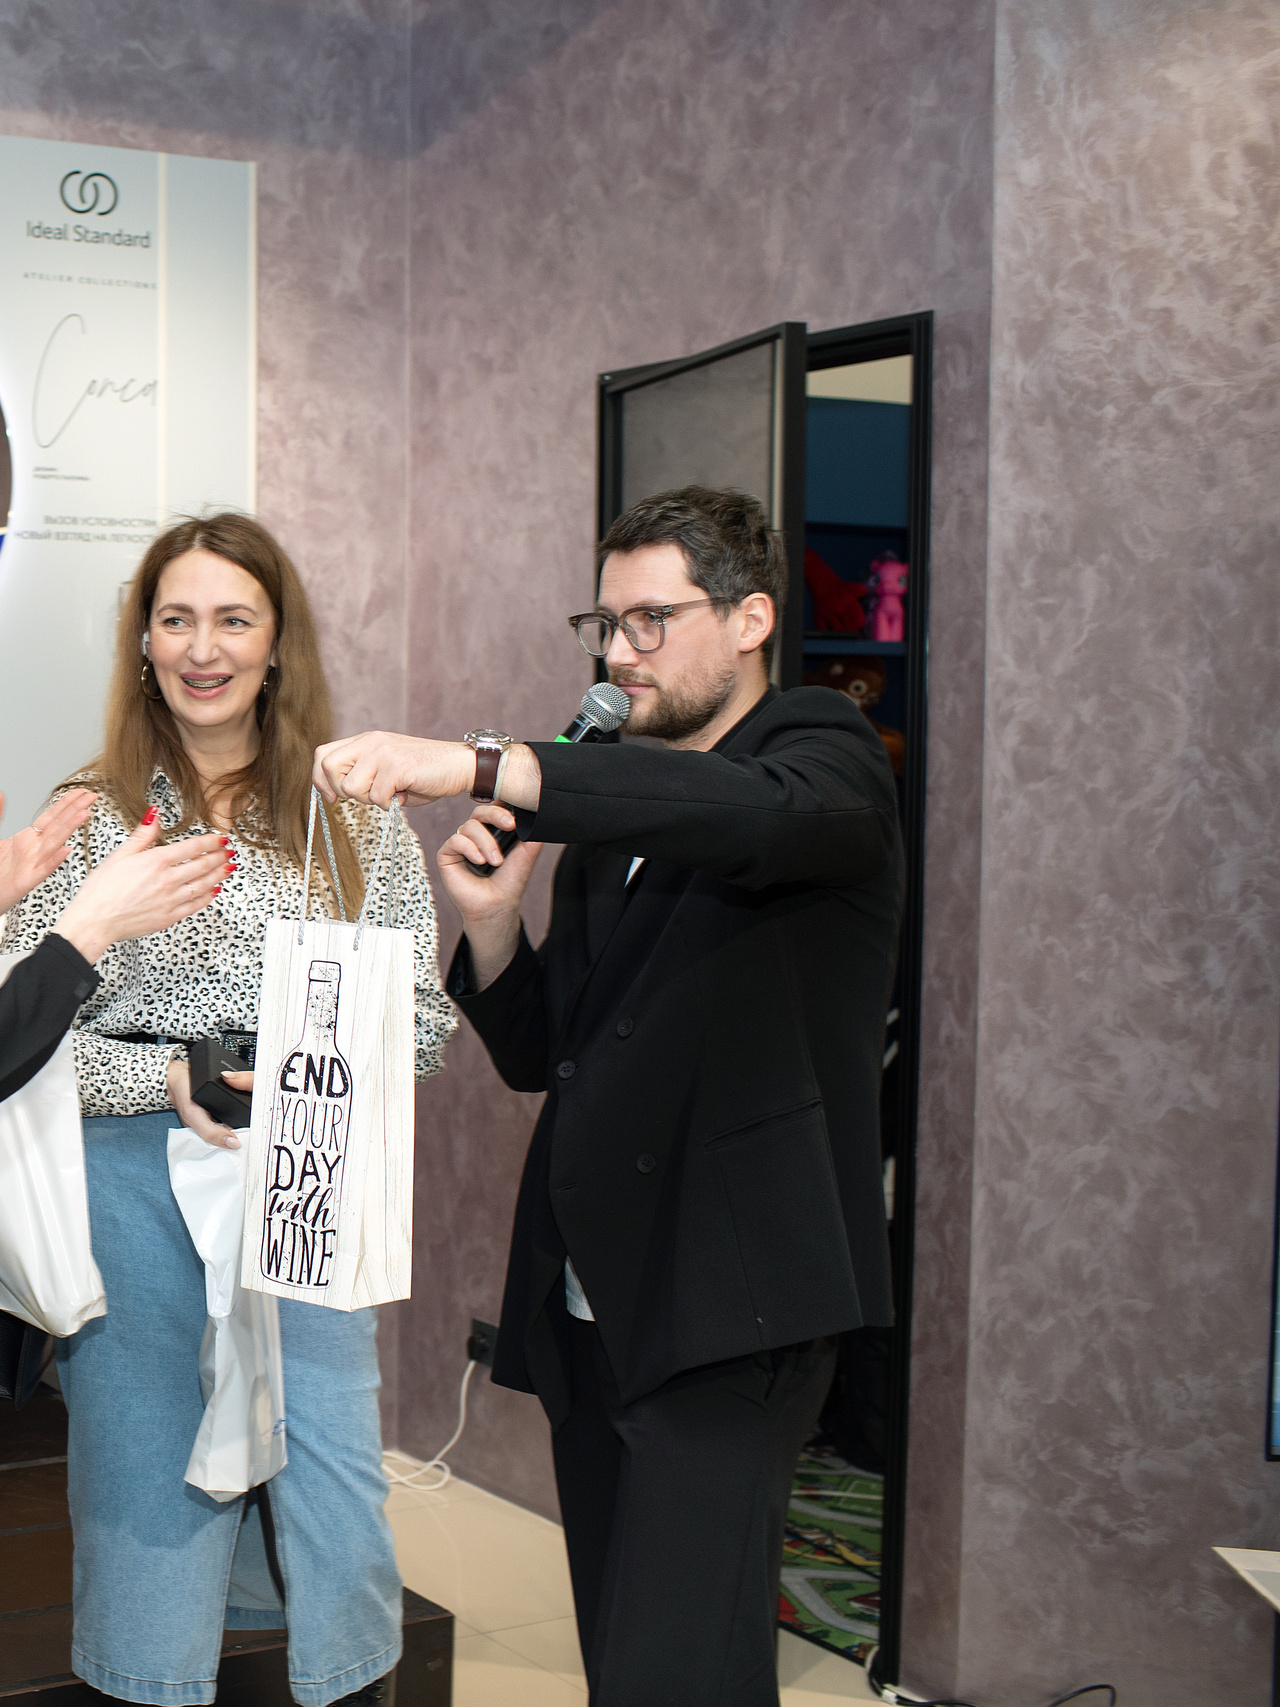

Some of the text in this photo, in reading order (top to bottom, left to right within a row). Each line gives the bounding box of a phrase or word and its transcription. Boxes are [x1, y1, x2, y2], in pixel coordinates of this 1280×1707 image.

[26, 220, 150, 248] Ideal Standard
[280, 1051, 349, 1097] END
[280, 1096, 342, 1152] YOUR
[273, 1144, 342, 1192] DAY
[268, 1186, 335, 1229] with
[266, 1217, 336, 1286] WINE
